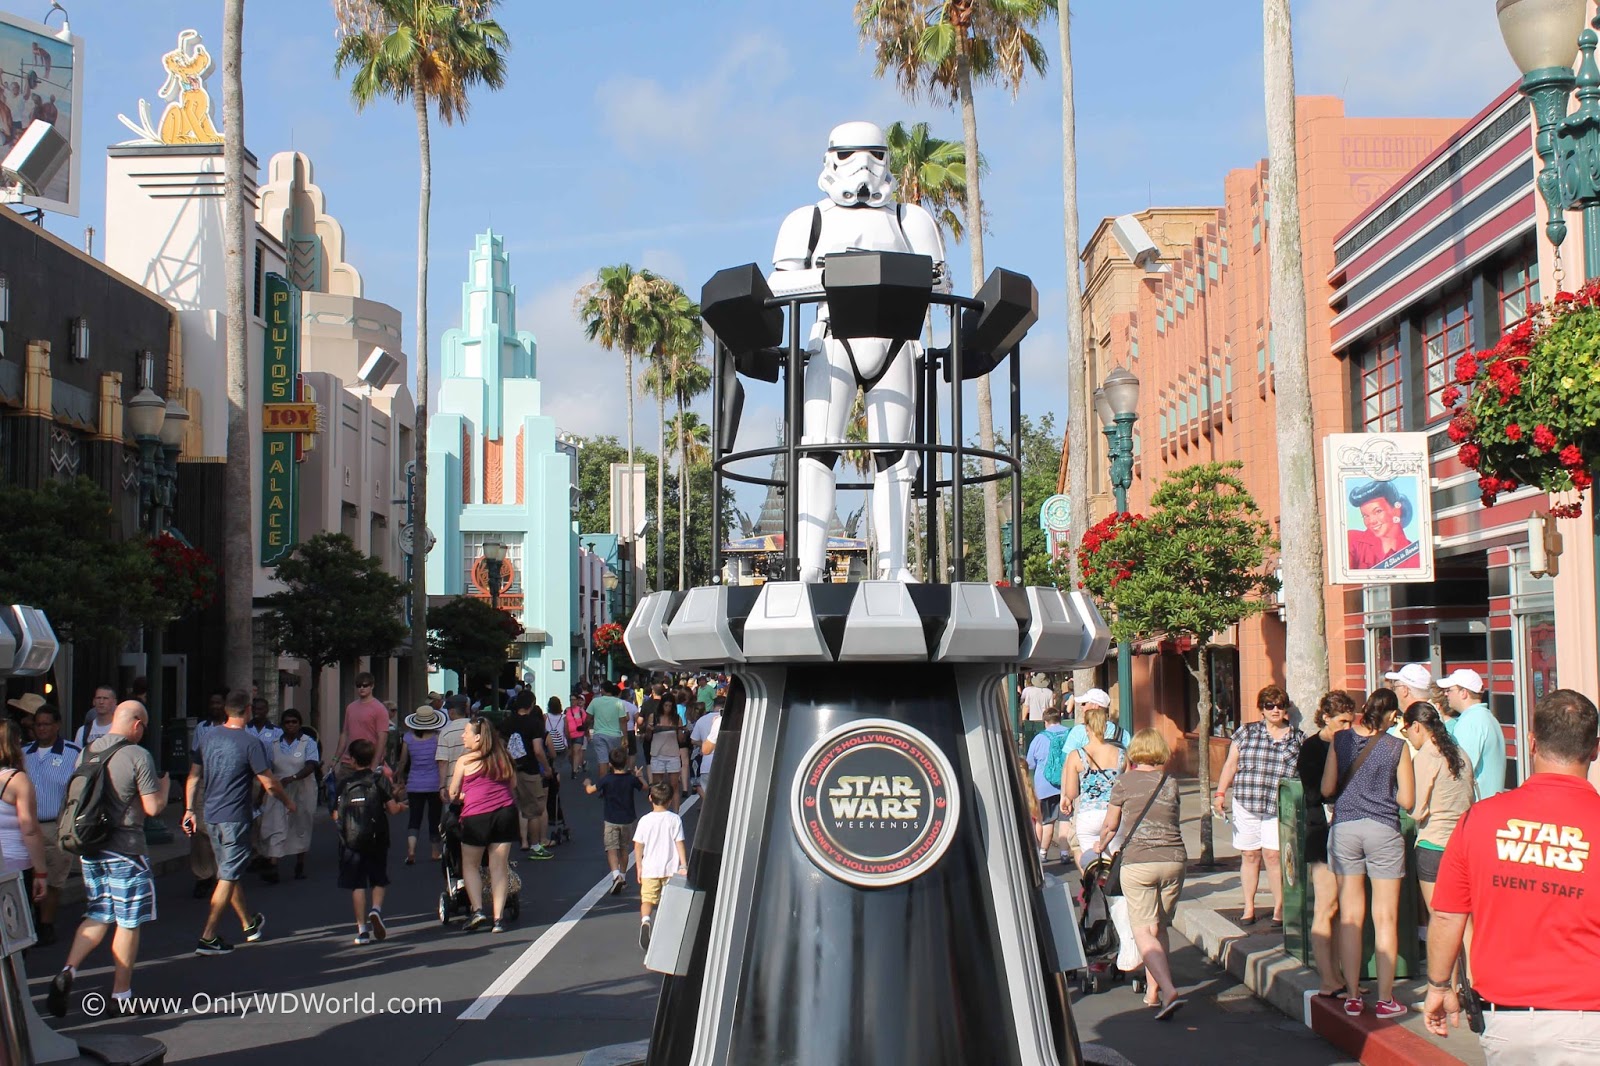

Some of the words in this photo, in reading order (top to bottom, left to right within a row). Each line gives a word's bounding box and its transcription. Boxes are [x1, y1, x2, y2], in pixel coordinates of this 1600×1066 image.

[272, 291, 290, 397] PLUTO'S
[268, 409, 312, 426] TOY
[268, 441, 285, 546] PALACE
[810, 746, 843, 786] DISNEY'S
[841, 734, 910, 751] HOLLYWOOD
[909, 746, 942, 787] STUDIOS
[828, 775, 921, 796] STAR
[829, 797, 921, 820] WARS
[835, 821, 919, 829] WEEKENDS
[810, 820, 843, 862] DISNEY'S
[842, 857, 912, 873] HOLLYWOOD
[911, 820, 943, 861] STUDIOS
[1496, 818, 1590, 851] STAR
[1496, 838, 1589, 872] WARS
[1492, 875, 1537, 891] EVENT
[1541, 882, 1584, 899] STAFF
